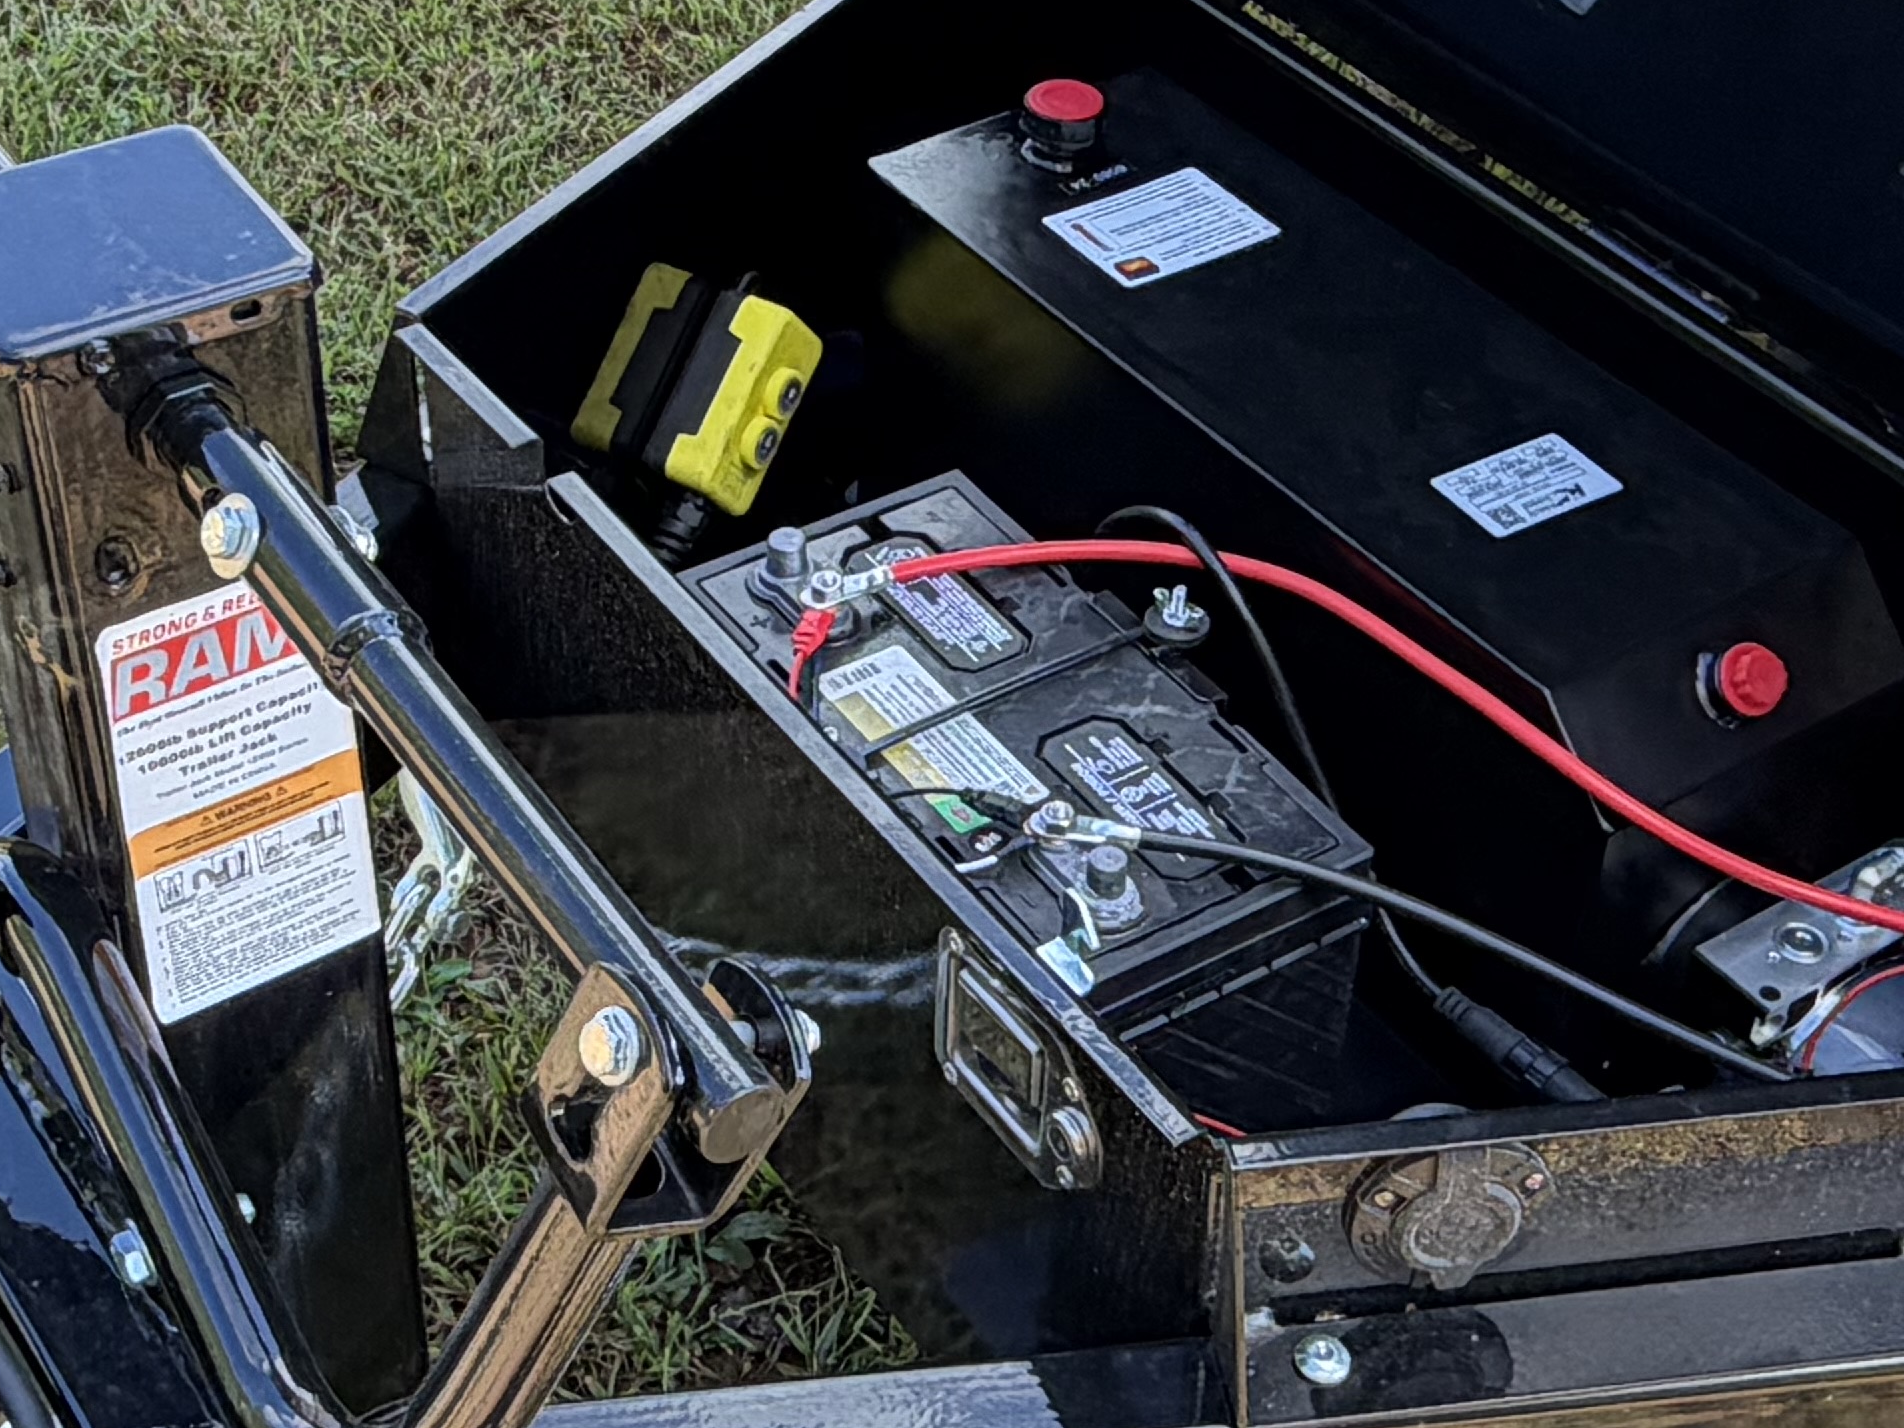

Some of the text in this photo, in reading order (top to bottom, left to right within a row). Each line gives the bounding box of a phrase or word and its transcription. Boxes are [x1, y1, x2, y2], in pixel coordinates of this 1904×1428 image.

[112, 613, 197, 655] STRONG
[202, 604, 215, 621] &
[115, 609, 291, 719] RAM
[186, 706, 253, 739] Support
[255, 681, 319, 713] Capacit
[208, 730, 236, 749] Lift
[240, 701, 312, 736] Capacity
[178, 733, 278, 778] Trailer Jack
